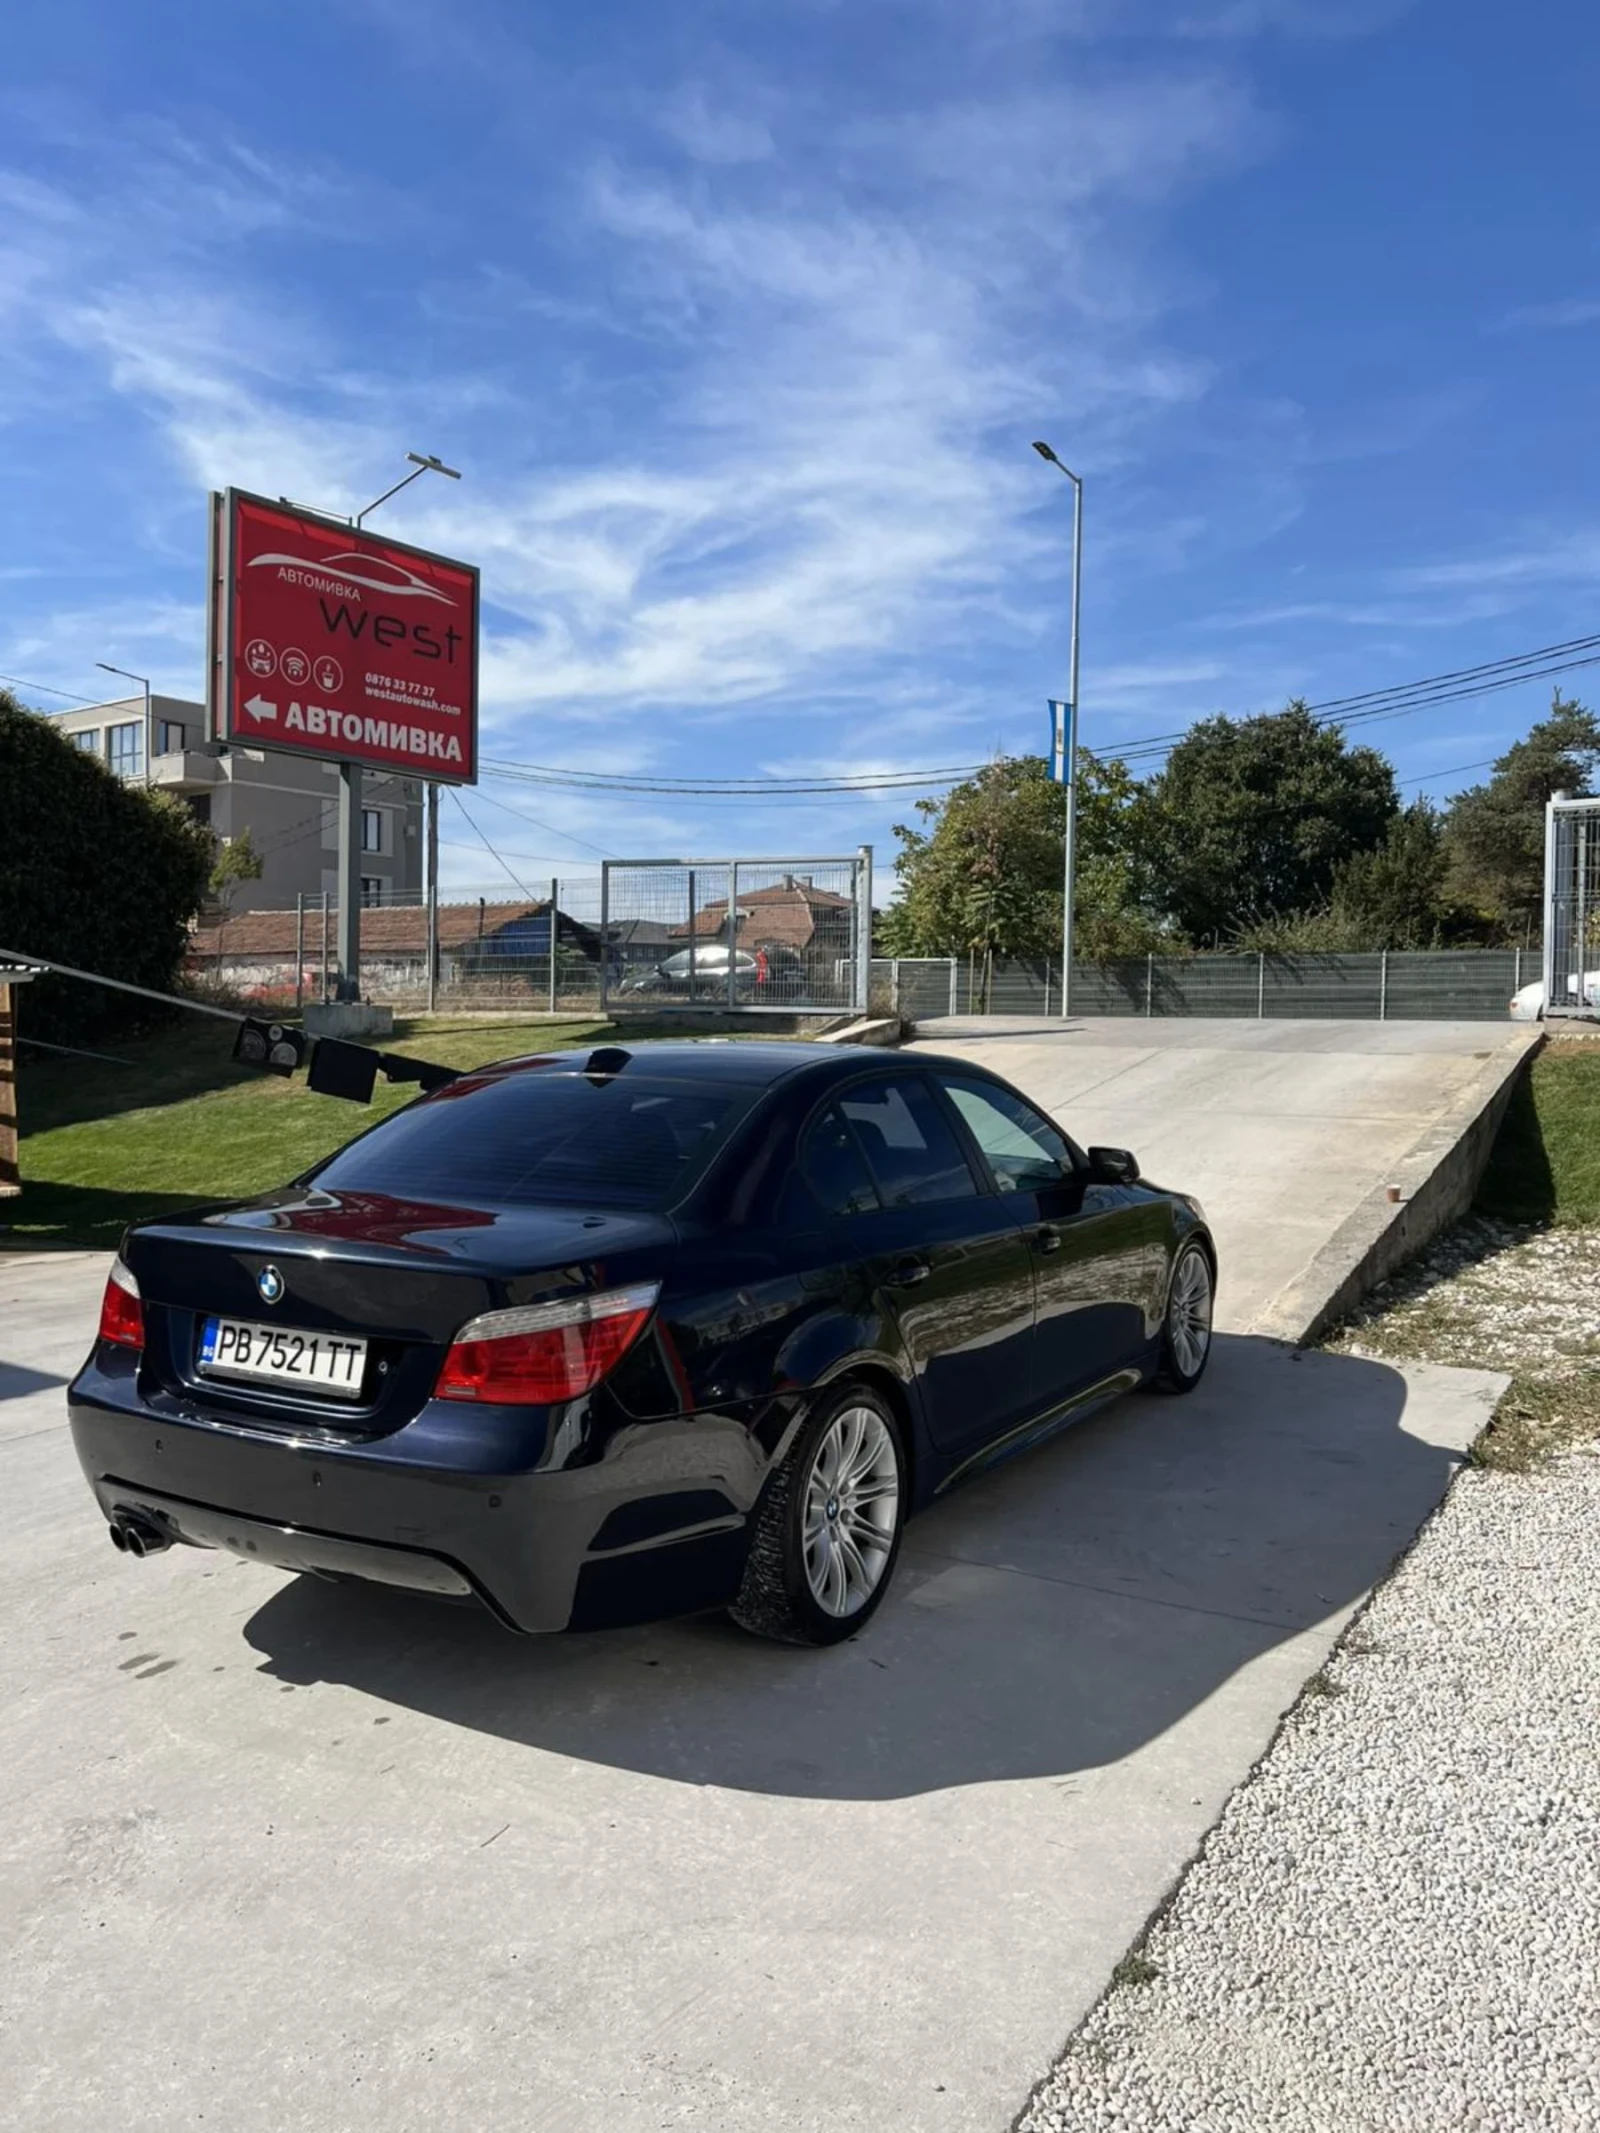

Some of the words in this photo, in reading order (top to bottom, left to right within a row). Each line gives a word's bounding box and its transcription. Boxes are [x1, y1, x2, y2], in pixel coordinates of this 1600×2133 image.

[277, 566, 362, 602] АВТОМИВКА
[319, 598, 463, 664] west
[364, 672, 392, 688] 0876
[393, 678, 406, 691] 33
[408, 682, 421, 695] 77
[422, 685, 436, 698] 37
[364, 685, 462, 716] westautowash.com
[284, 701, 463, 763] АВТОМИВКА
